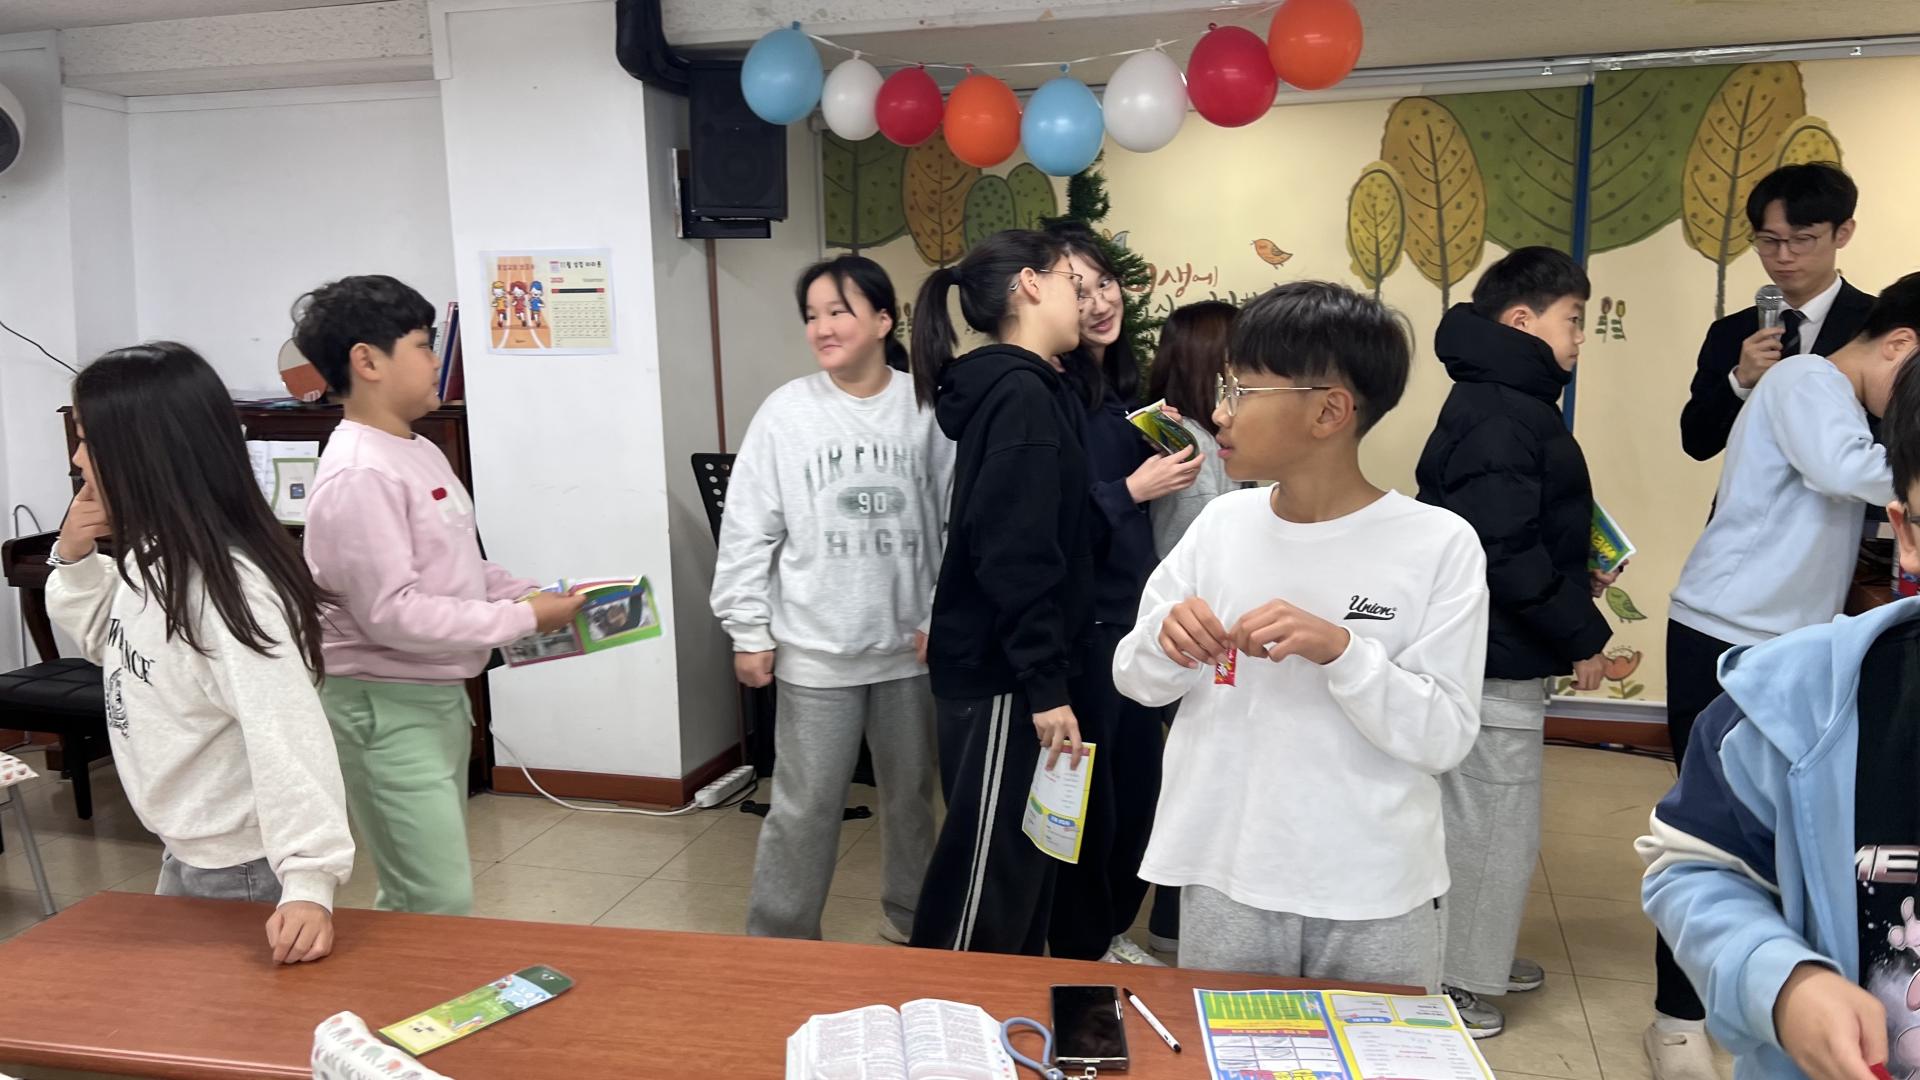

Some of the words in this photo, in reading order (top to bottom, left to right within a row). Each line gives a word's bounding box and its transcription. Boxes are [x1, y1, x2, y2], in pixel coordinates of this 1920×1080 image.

[858, 492, 887, 514] 90
[824, 529, 921, 557] HIGH
[1347, 595, 1395, 618] Union
